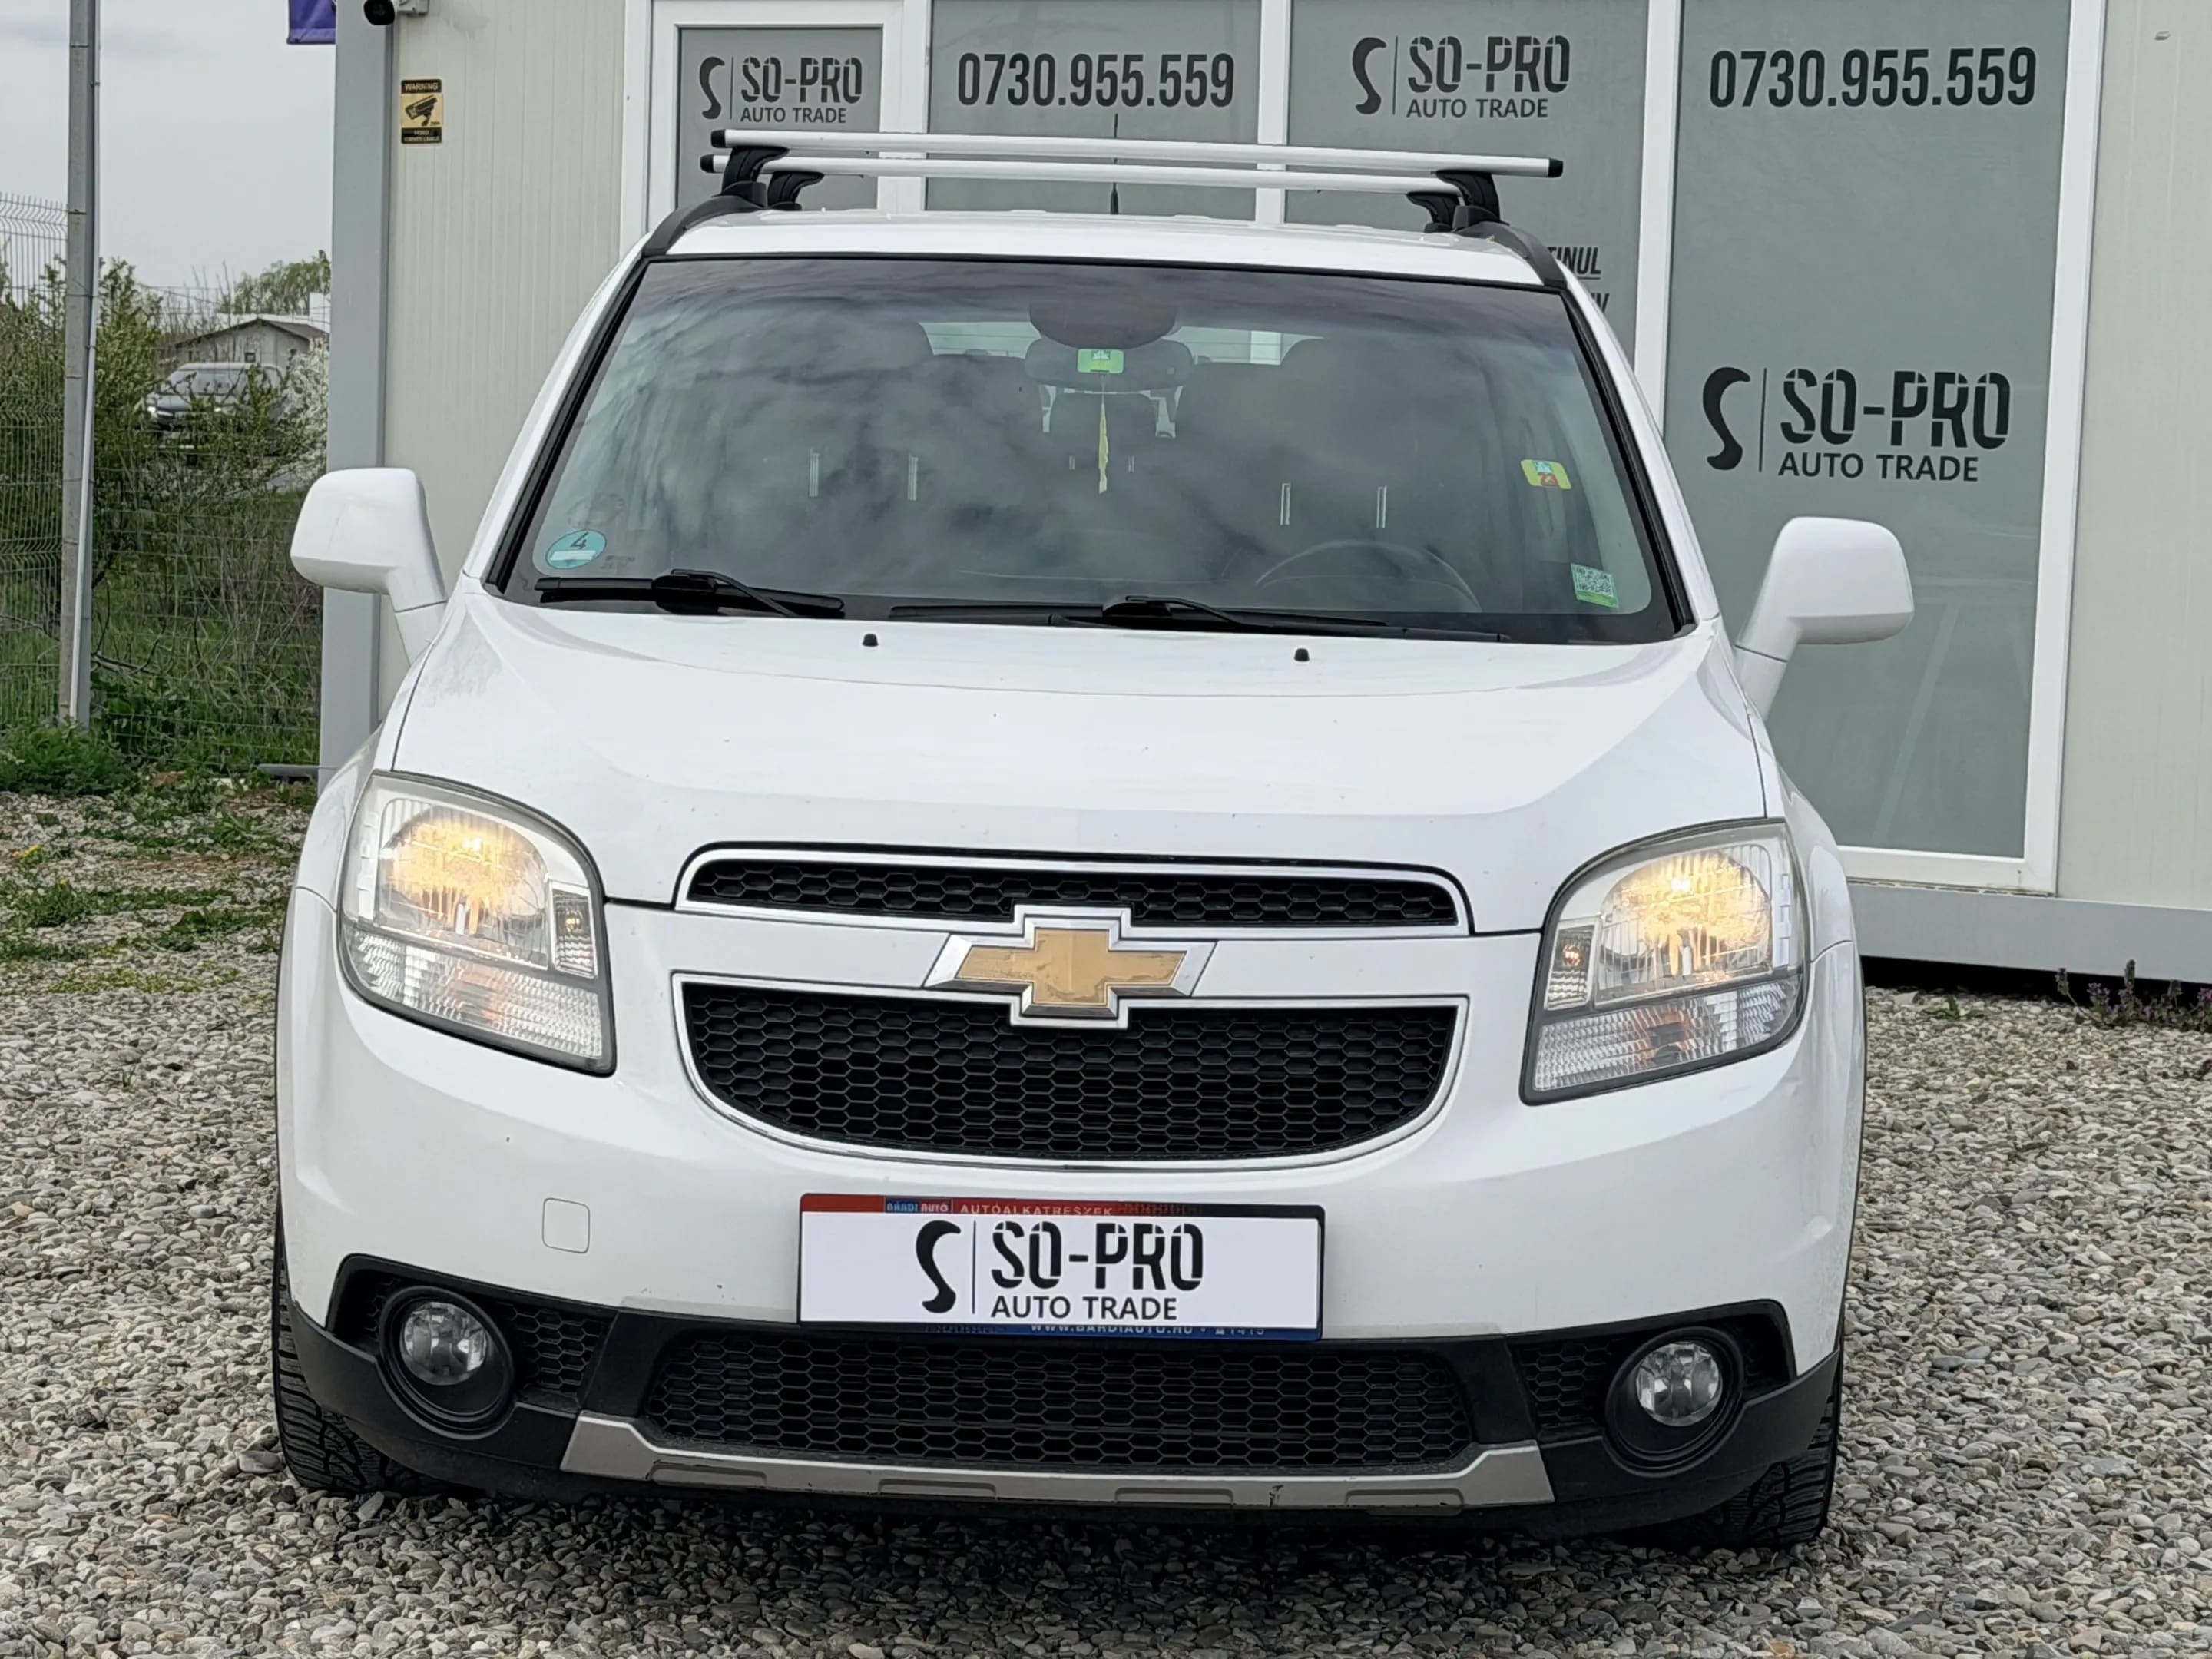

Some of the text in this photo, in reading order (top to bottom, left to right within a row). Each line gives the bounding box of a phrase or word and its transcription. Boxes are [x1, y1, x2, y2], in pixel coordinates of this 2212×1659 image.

[740, 55, 863, 104] SO-PRO
[957, 52, 1235, 108] 0730.955.559
[1407, 35, 1571, 94] SO-PRO
[1710, 46, 2038, 108] 0730.955.559
[739, 106, 847, 124] AUTO TRADE
[1406, 98, 1549, 119] AUTO TRADE
[1779, 367, 2011, 450] SO-PRO
[1777, 452, 1979, 482] AUTO TRADE
[569, 531, 589, 550] 4
[991, 1220, 1204, 1292] SO-PRO
[991, 1295, 1177, 1321] AUTO TRADE
